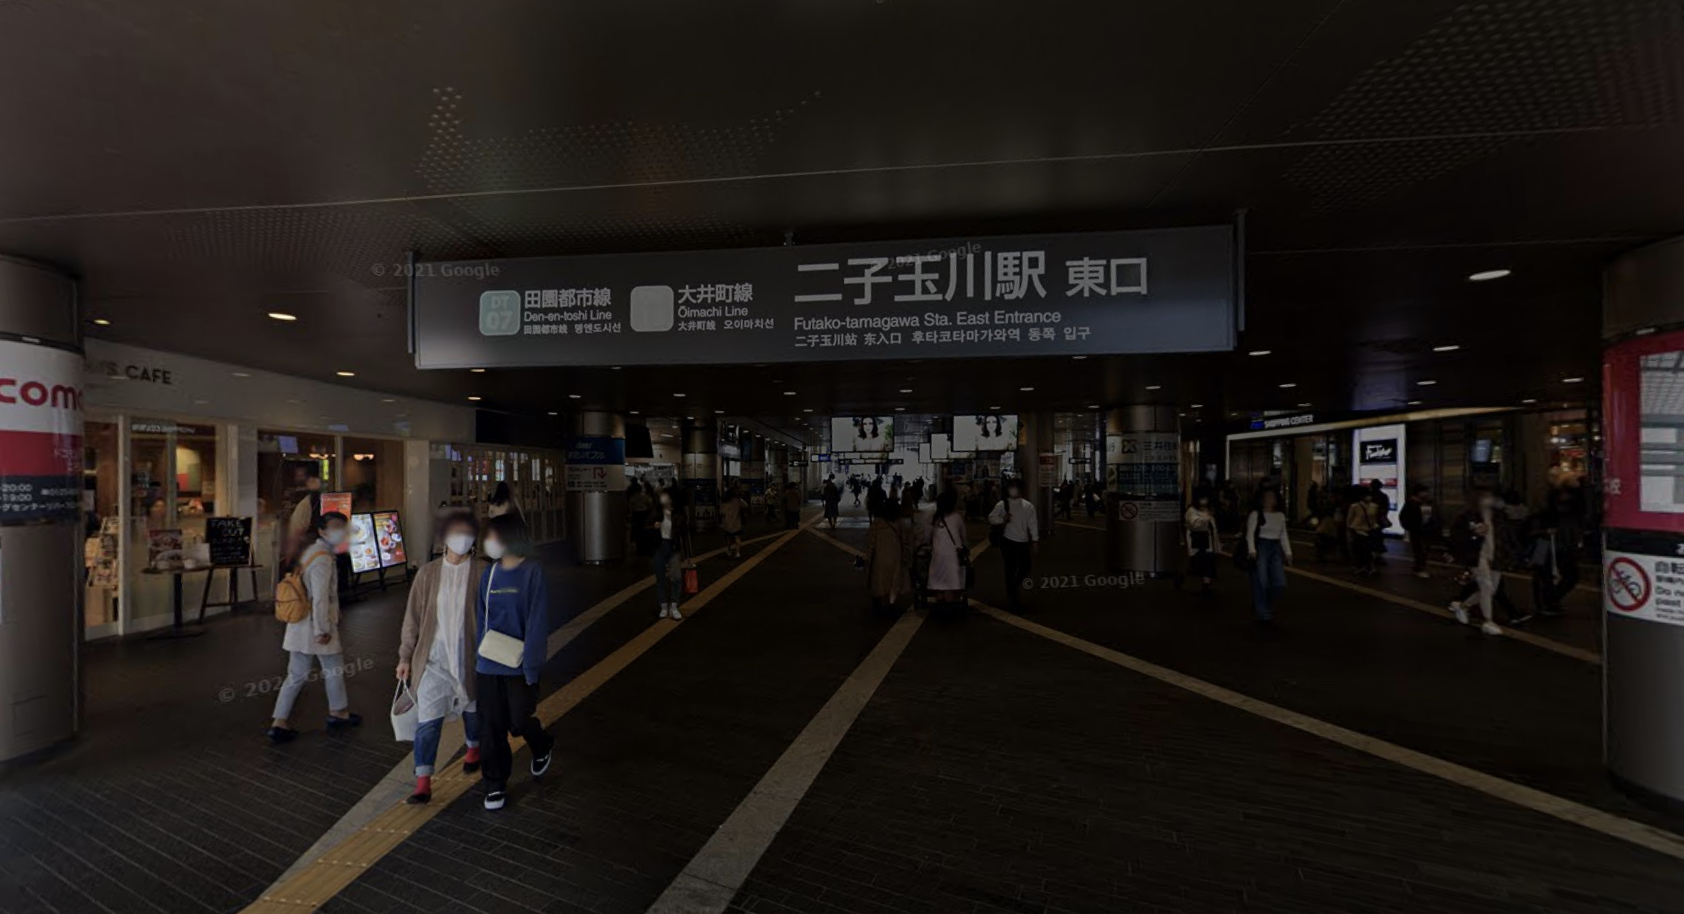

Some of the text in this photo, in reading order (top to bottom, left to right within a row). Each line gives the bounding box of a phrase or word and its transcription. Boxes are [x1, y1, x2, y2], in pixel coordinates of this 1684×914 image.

[794, 250, 1148, 305] 二子玉川駅 東口
[524, 287, 612, 309] 田園都市線
[678, 282, 753, 304] 大井町線
[524, 309, 612, 322] Den-en-toshi Line
[725, 305, 748, 316] Line
[486, 311, 512, 330] 07
[723, 318, 775, 330] 오이마치선
[794, 310, 1062, 331] Futako-tamagawa Sta. East Entrance
[794, 332, 902, 347] 二子玉川站 东入口
[911, 328, 1021, 344] 후타코타마가와역
[1063, 326, 1091, 340] 입구
[125, 364, 173, 385] CAFE
[0, 378, 83, 410] com
[1290, 413, 1314, 426] CENTER
